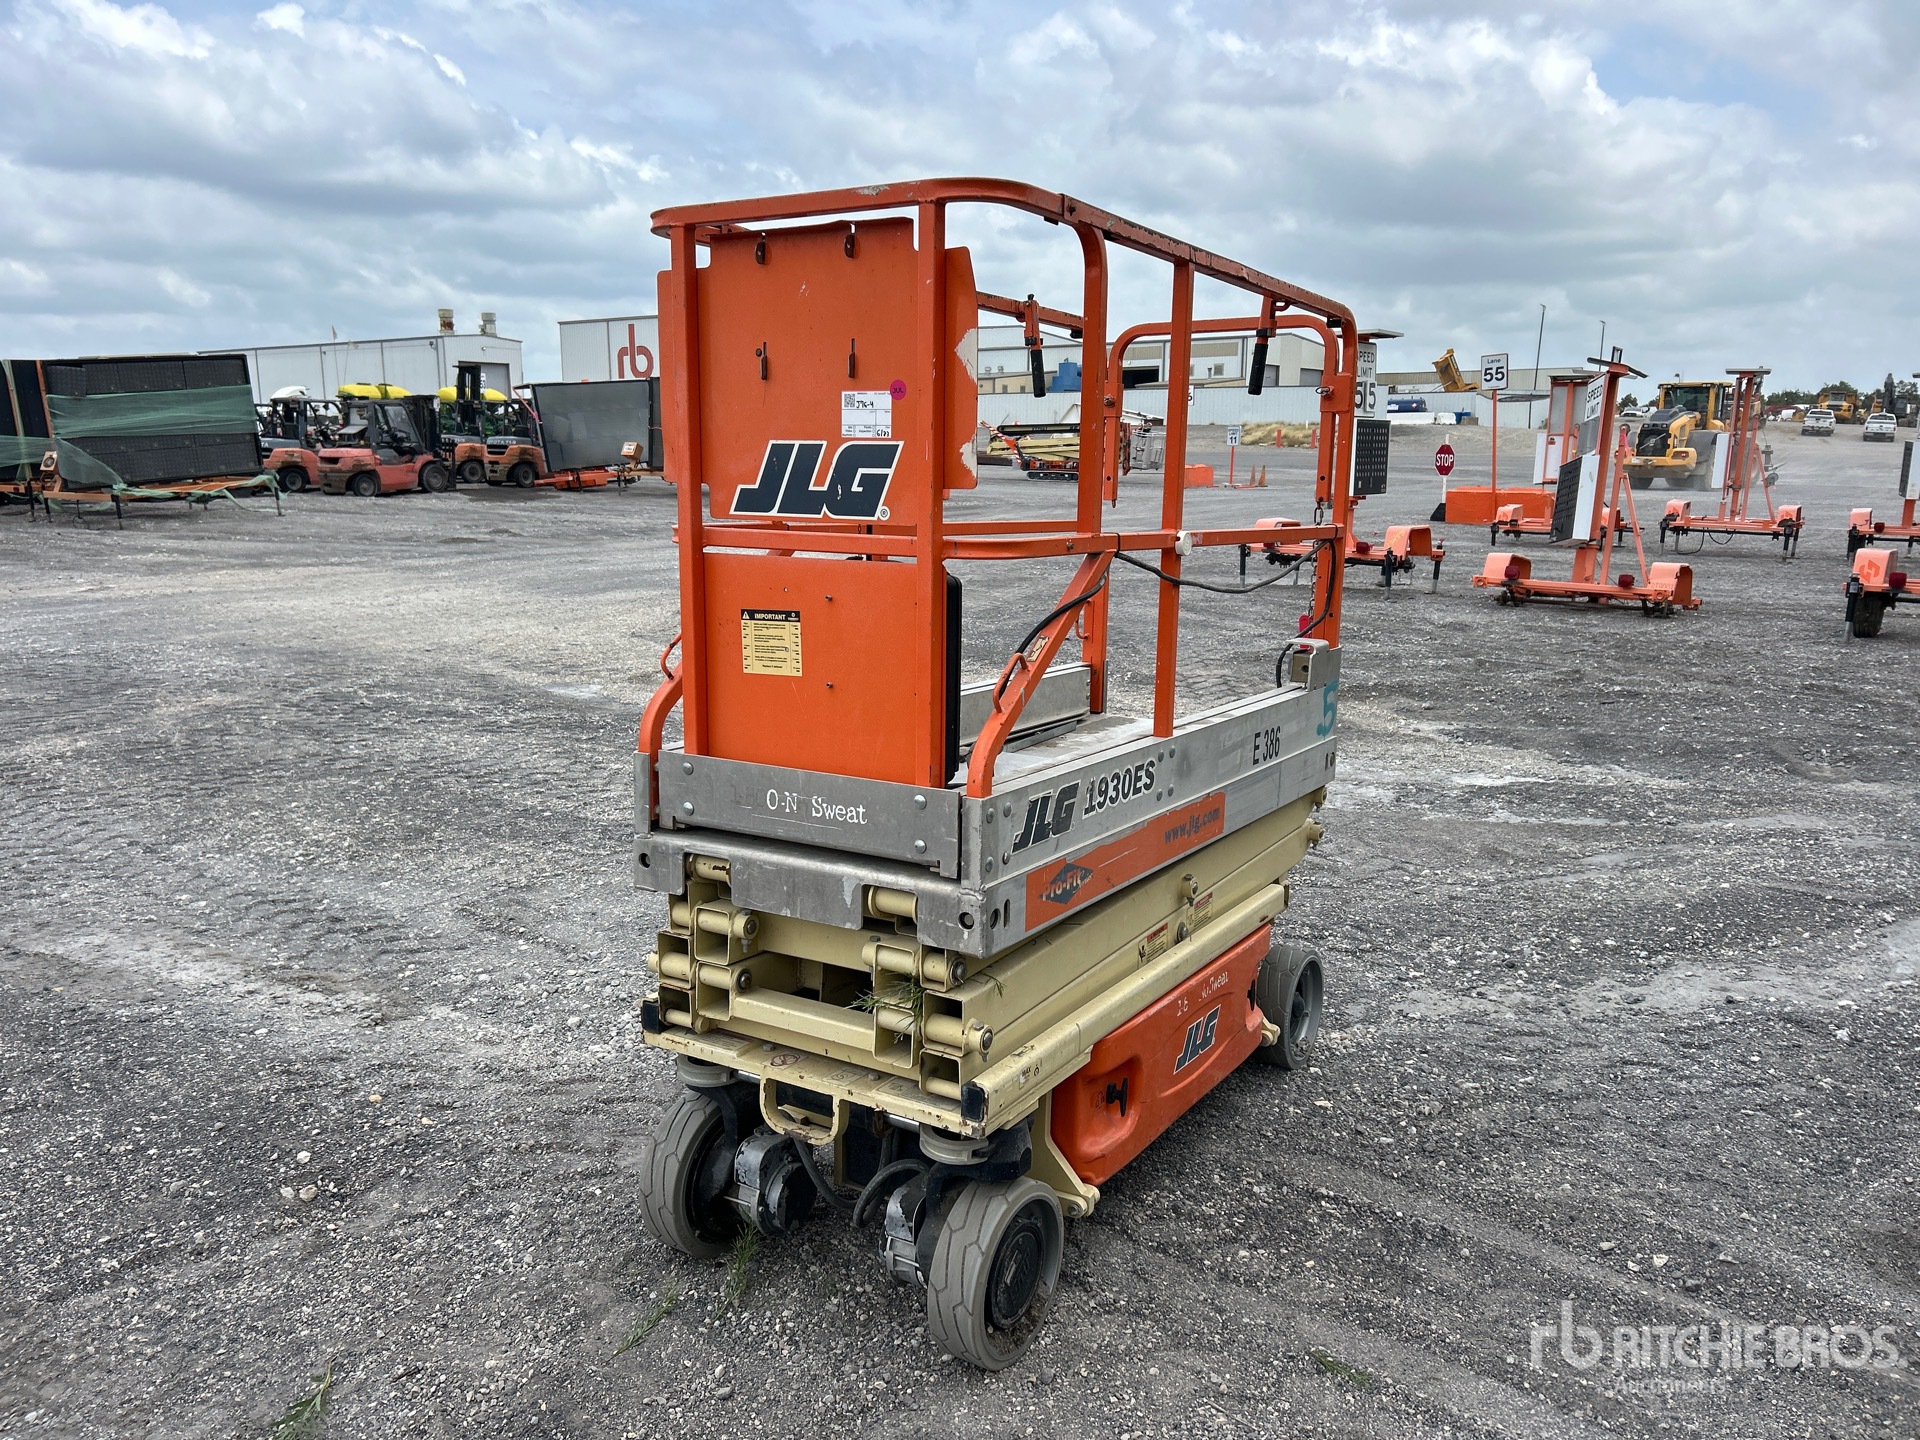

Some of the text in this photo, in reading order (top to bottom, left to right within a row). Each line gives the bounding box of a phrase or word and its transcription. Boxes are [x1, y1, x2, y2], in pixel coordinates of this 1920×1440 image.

[617, 323, 654, 378] rb
[1358, 351, 1375, 363] PEED
[1357, 367, 1373, 378] IMIT
[1483, 366, 1505, 382] 55
[1355, 382, 1376, 409] 55
[1587, 384, 1603, 404] SPEED
[1586, 402, 1600, 419] LIMIT
[1230, 436, 1237, 444] 11
[1436, 454, 1454, 467] STOP
[730, 441, 904, 520] JLG
[754, 613, 786, 621] IMPORTANT
[1316, 678, 1340, 739] 5
[1253, 725, 1280, 766] E 386
[811, 795, 868, 825] Sweat
[1011, 756, 1157, 855] JLG 1930ES
[1164, 806, 1220, 845] www.jlg.com
[1173, 1003, 1221, 1076] JLG
